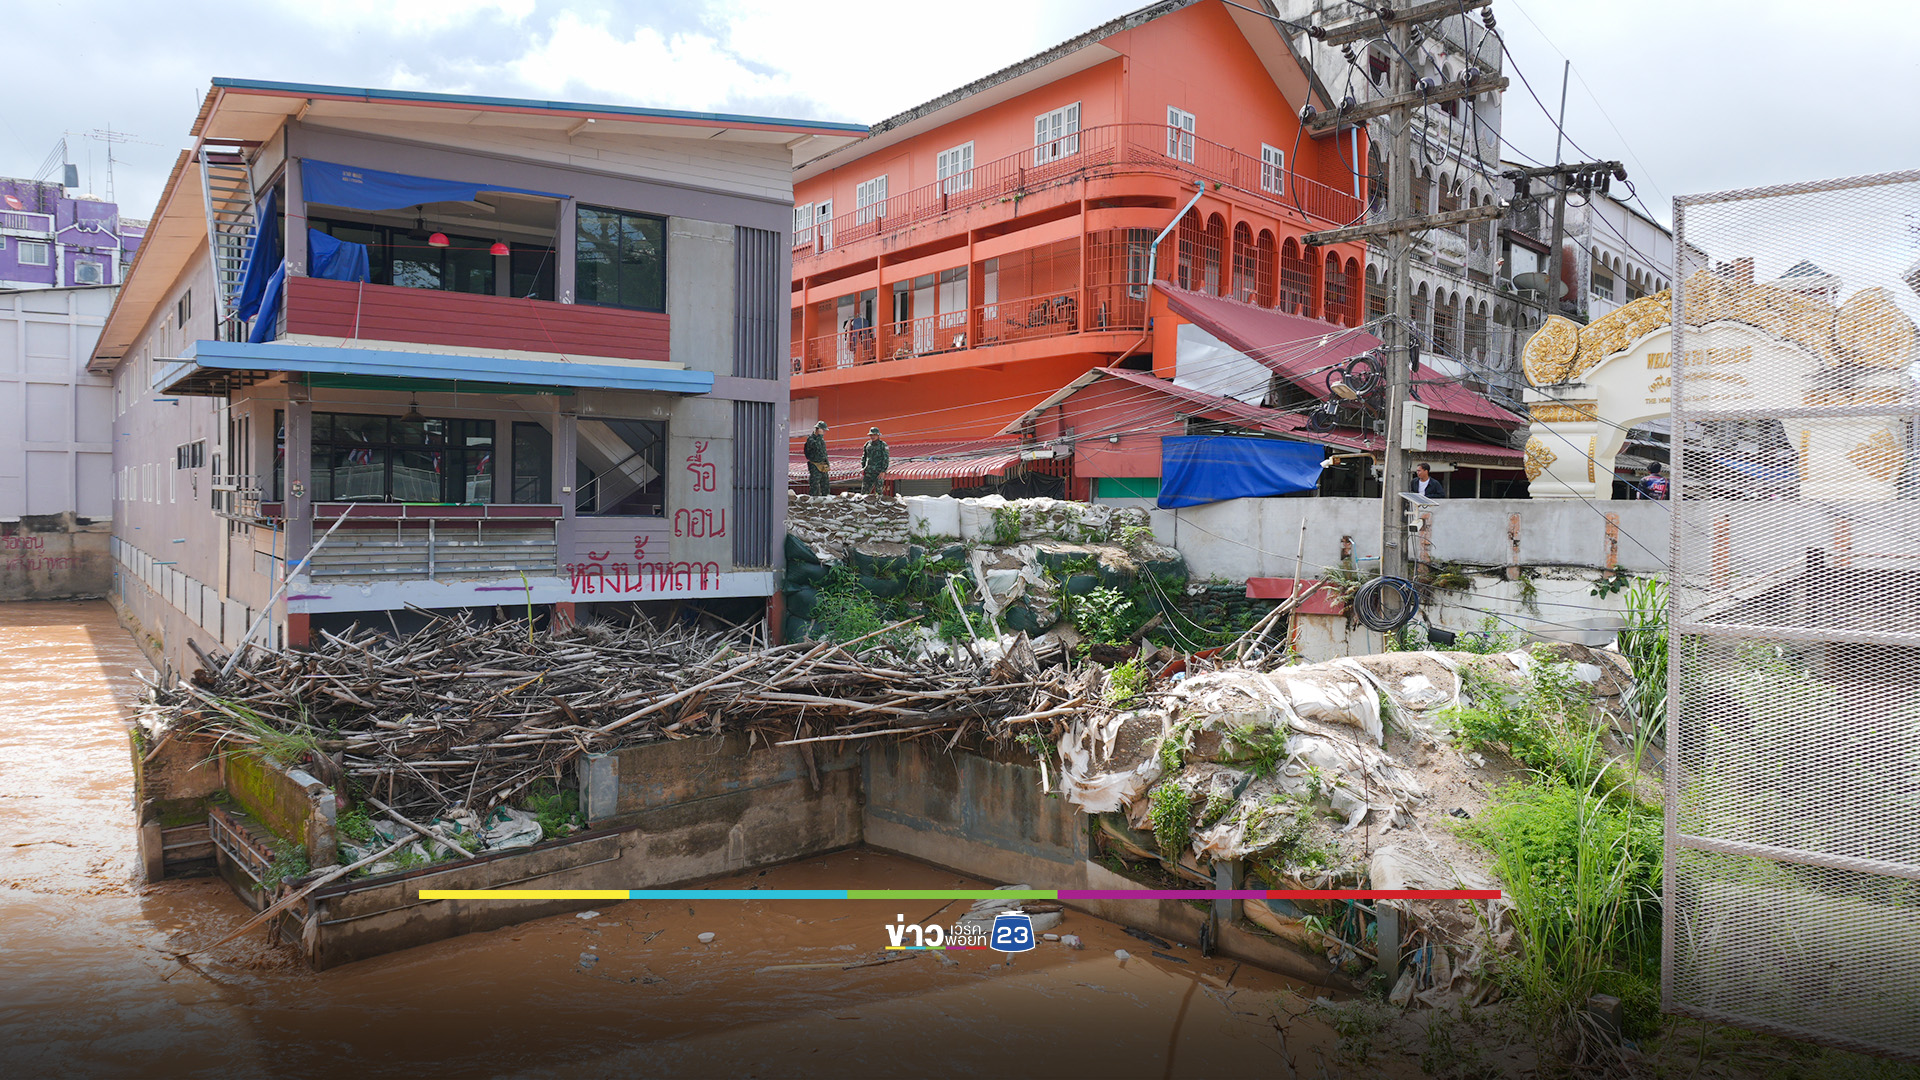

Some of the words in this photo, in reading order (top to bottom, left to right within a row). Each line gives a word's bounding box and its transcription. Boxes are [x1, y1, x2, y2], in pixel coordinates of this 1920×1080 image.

[686, 440, 716, 492] รื้อ
[674, 508, 726, 538] ถอน
[566, 535, 720, 594] หลังน้ำหลาก
